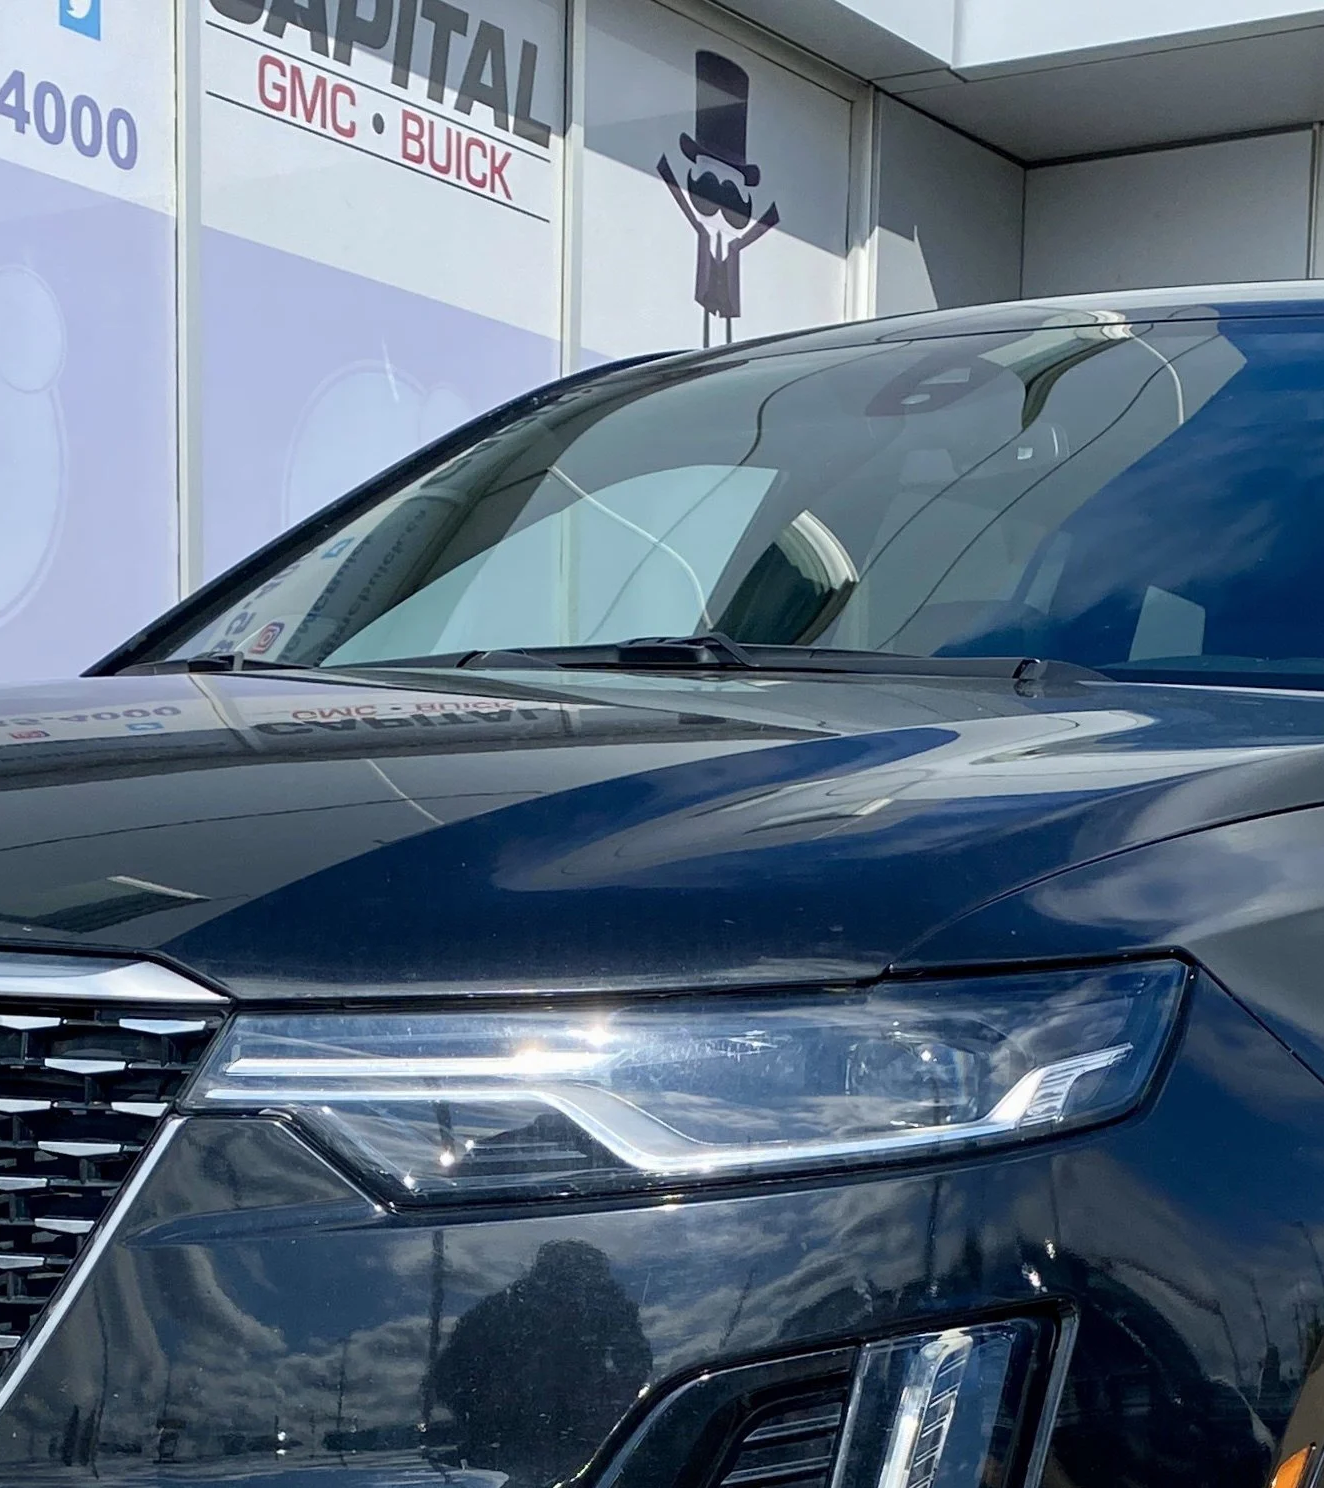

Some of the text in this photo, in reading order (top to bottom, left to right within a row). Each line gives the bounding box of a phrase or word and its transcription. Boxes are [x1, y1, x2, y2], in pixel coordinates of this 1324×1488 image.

[208, 0, 552, 149] APITAL
[257, 54, 513, 201] GMC BUICK
